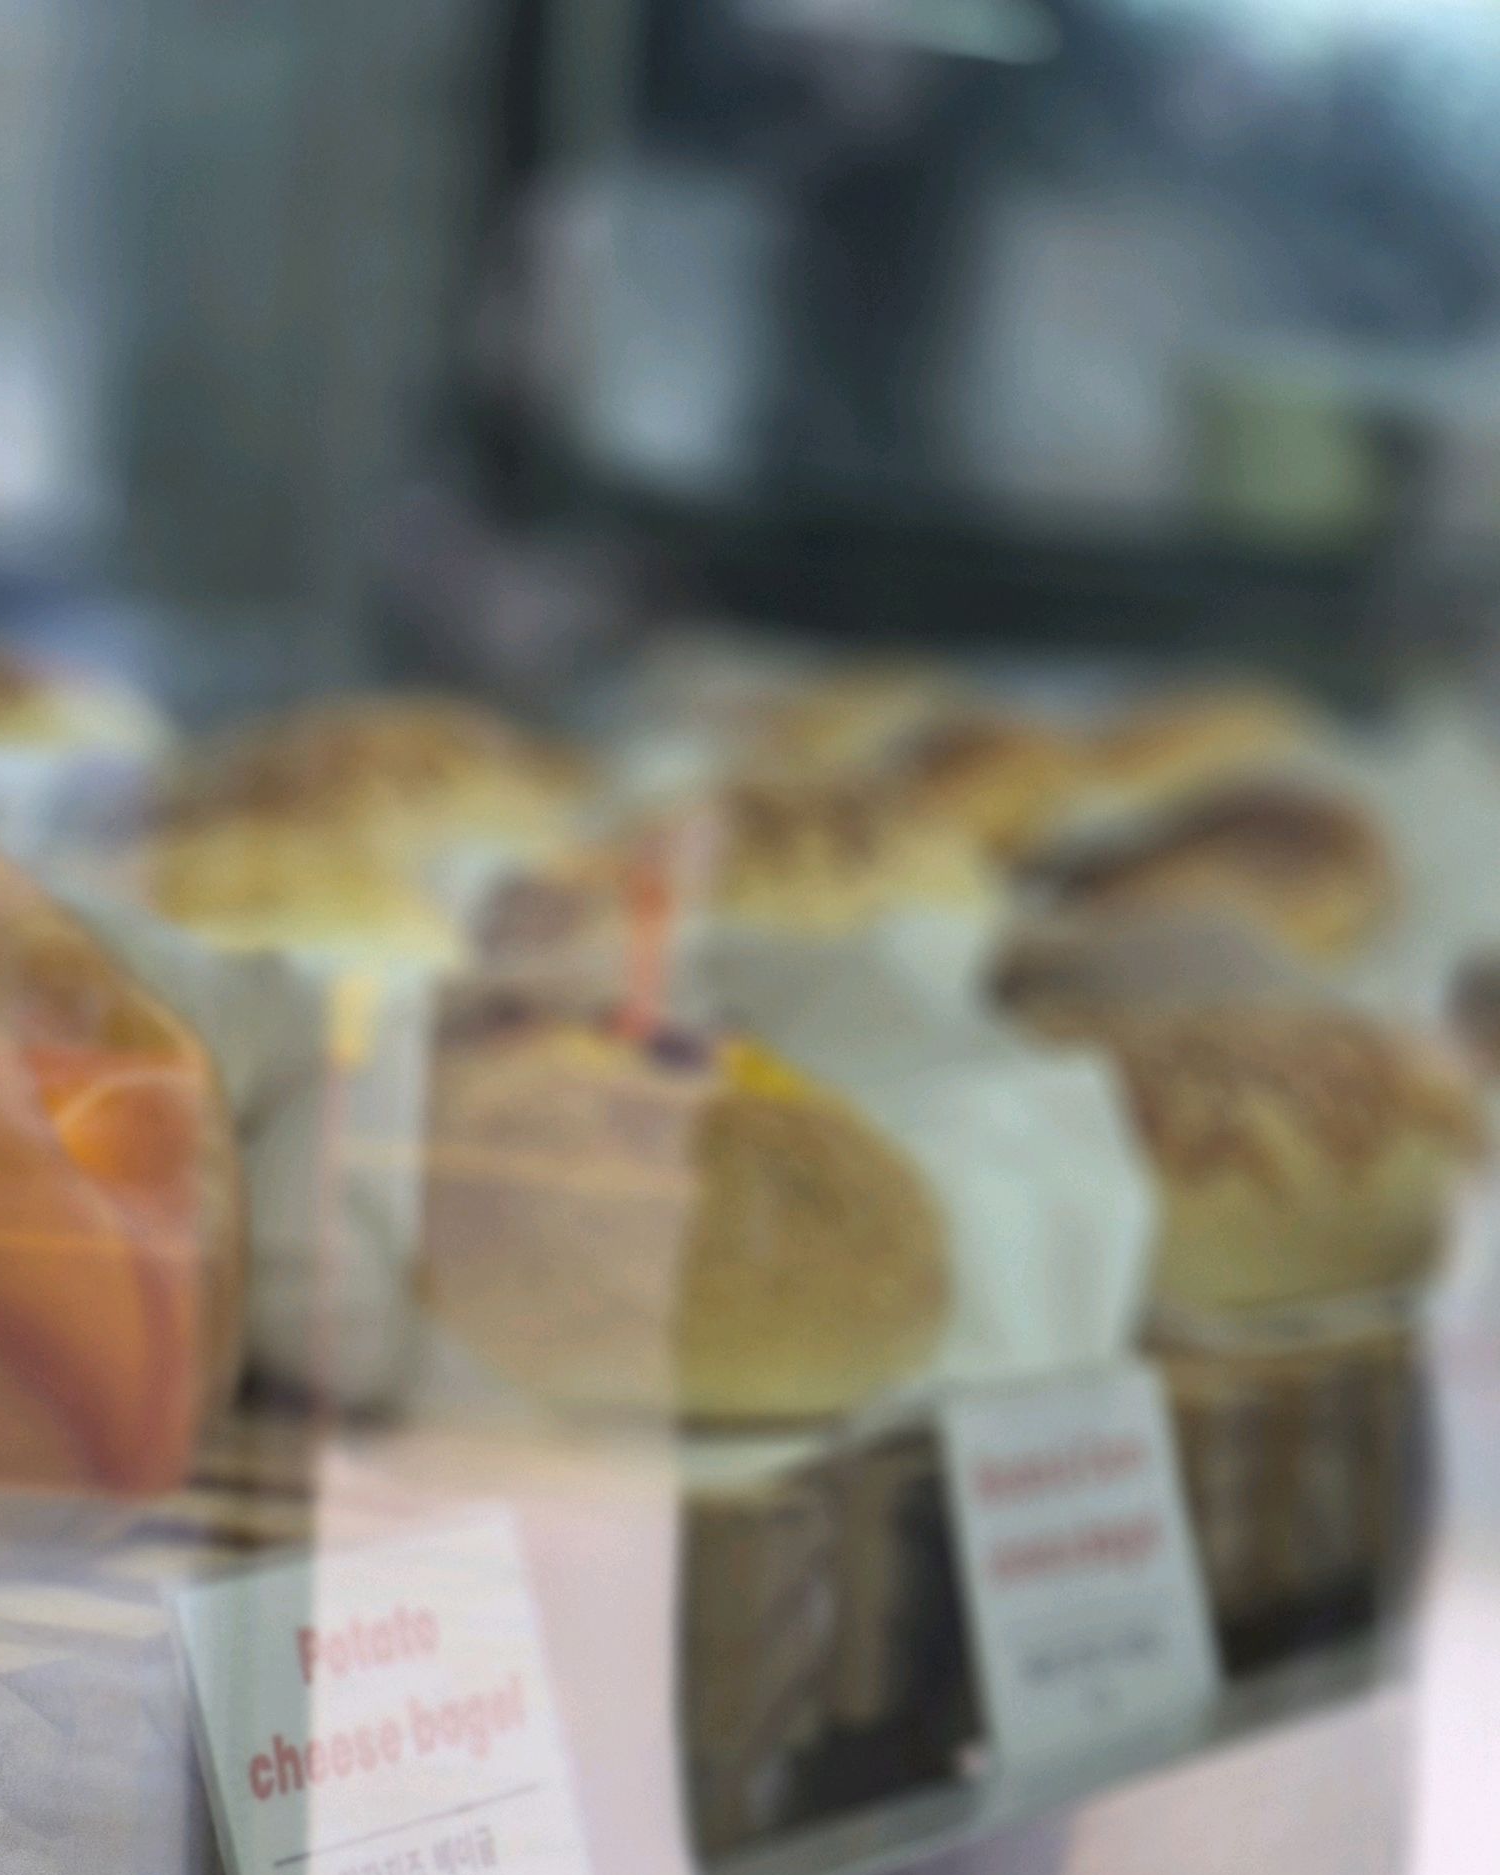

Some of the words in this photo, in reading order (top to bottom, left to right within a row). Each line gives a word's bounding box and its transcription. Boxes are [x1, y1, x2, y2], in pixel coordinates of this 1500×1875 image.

[294, 1604, 440, 1686] Potato
[249, 1716, 403, 1802] cheese
[405, 1672, 527, 1761] bagel
